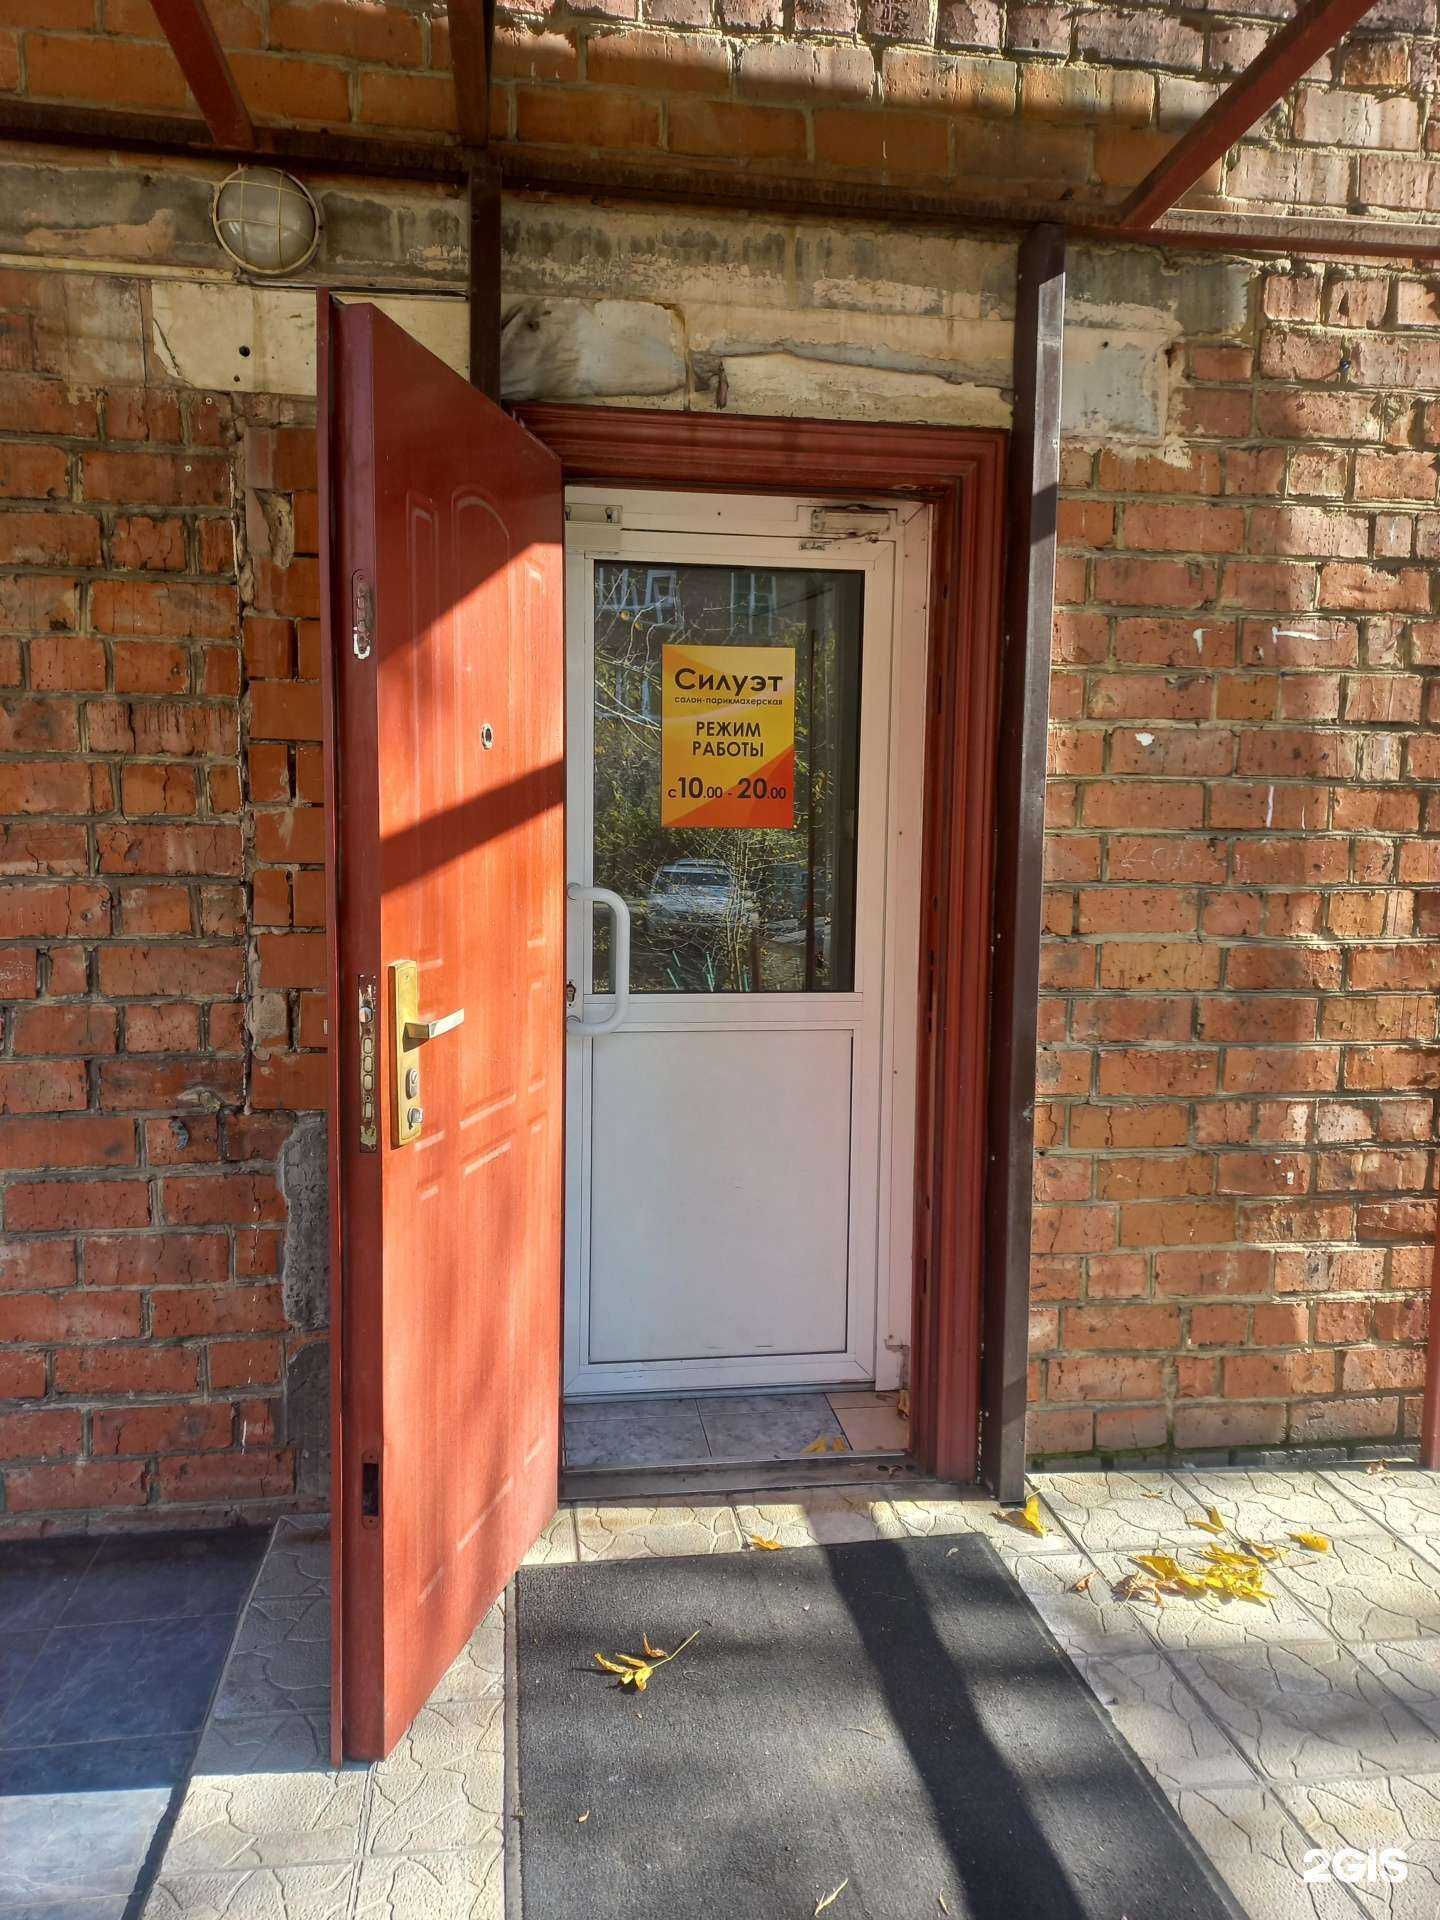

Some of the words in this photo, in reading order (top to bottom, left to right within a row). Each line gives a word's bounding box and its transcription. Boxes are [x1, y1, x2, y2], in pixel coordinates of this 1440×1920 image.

[674, 667, 783, 697] Силуэт
[674, 695, 783, 706] салон-парикмахерская
[696, 721, 761, 737] РЕЖИМ
[692, 741, 764, 757] РАБОТЫ
[737, 777, 786, 799] 20.00
